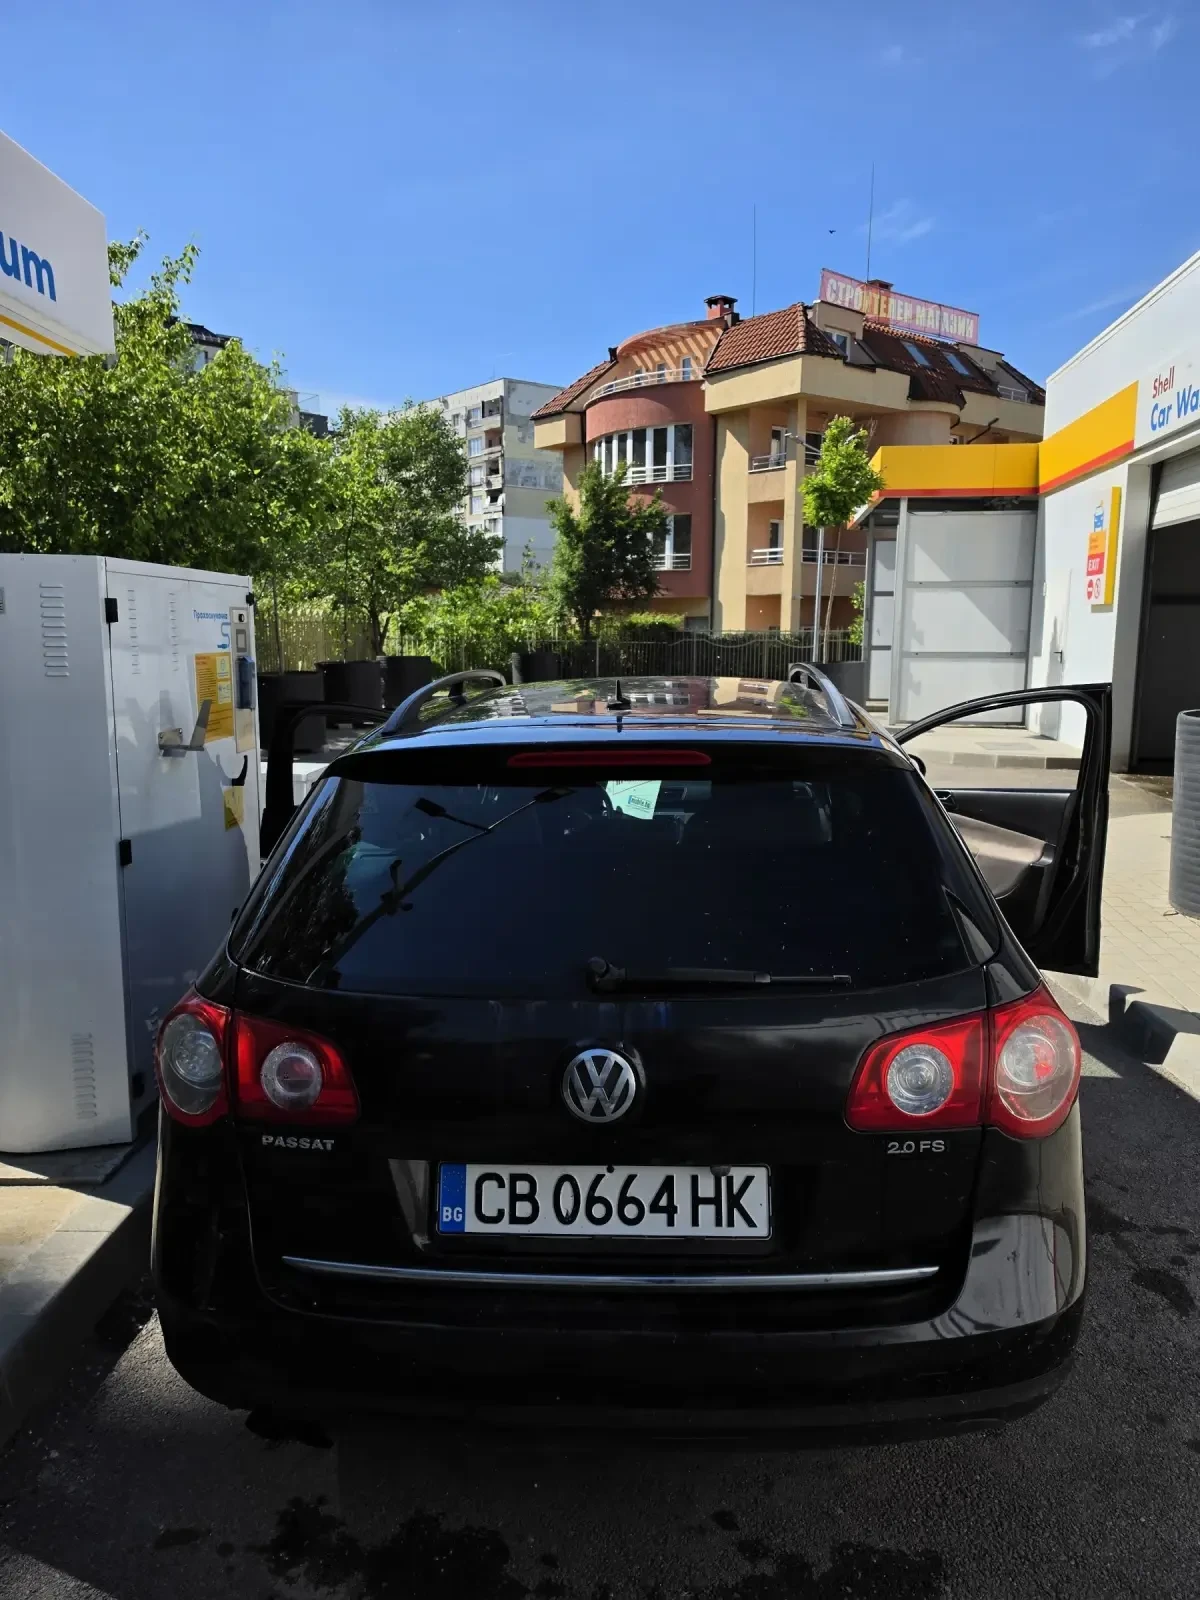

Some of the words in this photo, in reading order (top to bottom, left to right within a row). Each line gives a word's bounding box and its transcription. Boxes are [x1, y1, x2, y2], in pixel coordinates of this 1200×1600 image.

[825, 278, 913, 322] СТРОИТЕЛЕН
[915, 304, 974, 338] МАГАЗИН
[1152, 365, 1175, 399] Shell
[1150, 402, 1173, 431] Car
[1088, 557, 1101, 572] EXIT
[261, 1135, 335, 1151] PASSAT
[887, 1141, 916, 1154] 2.0
[919, 1140, 945, 1153] FS
[474, 1172, 540, 1225] CB
[553, 1173, 678, 1228] 0664
[690, 1173, 758, 1229] HK
[442, 1206, 463, 1223] BG
